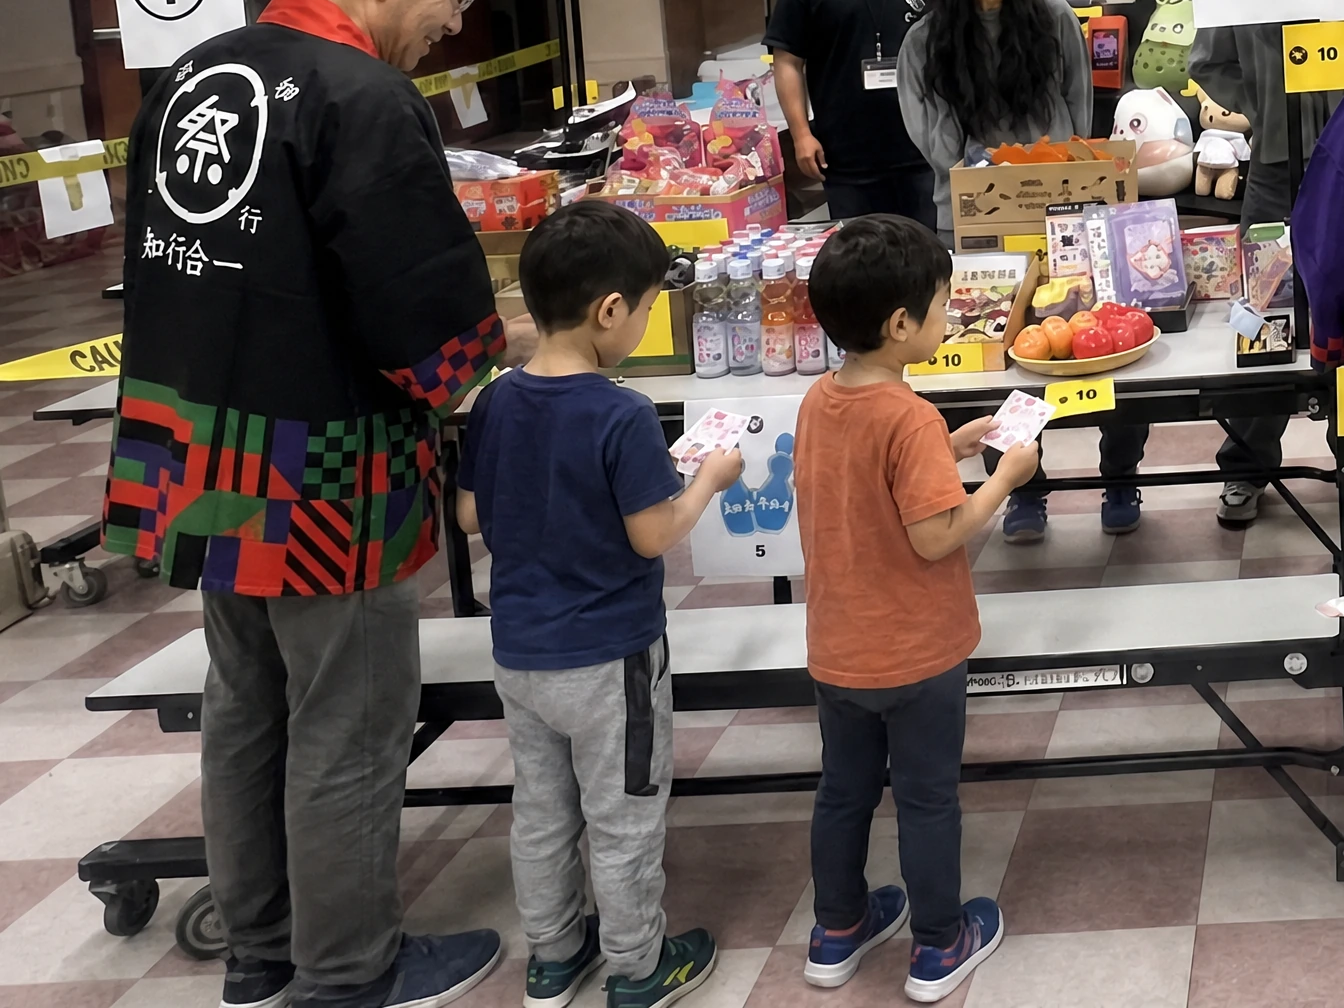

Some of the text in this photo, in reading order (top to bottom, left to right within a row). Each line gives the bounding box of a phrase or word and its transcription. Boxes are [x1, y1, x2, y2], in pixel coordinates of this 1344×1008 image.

[1317, 47, 1338, 61] 10
[174, 94, 239, 185] 祭
[238, 205, 263, 234] 行
[141, 226, 244, 276] 知行合一
[942, 353, 962, 367] 10
[1076, 389, 1097, 401] 10
[755, 544, 766, 558] 5
